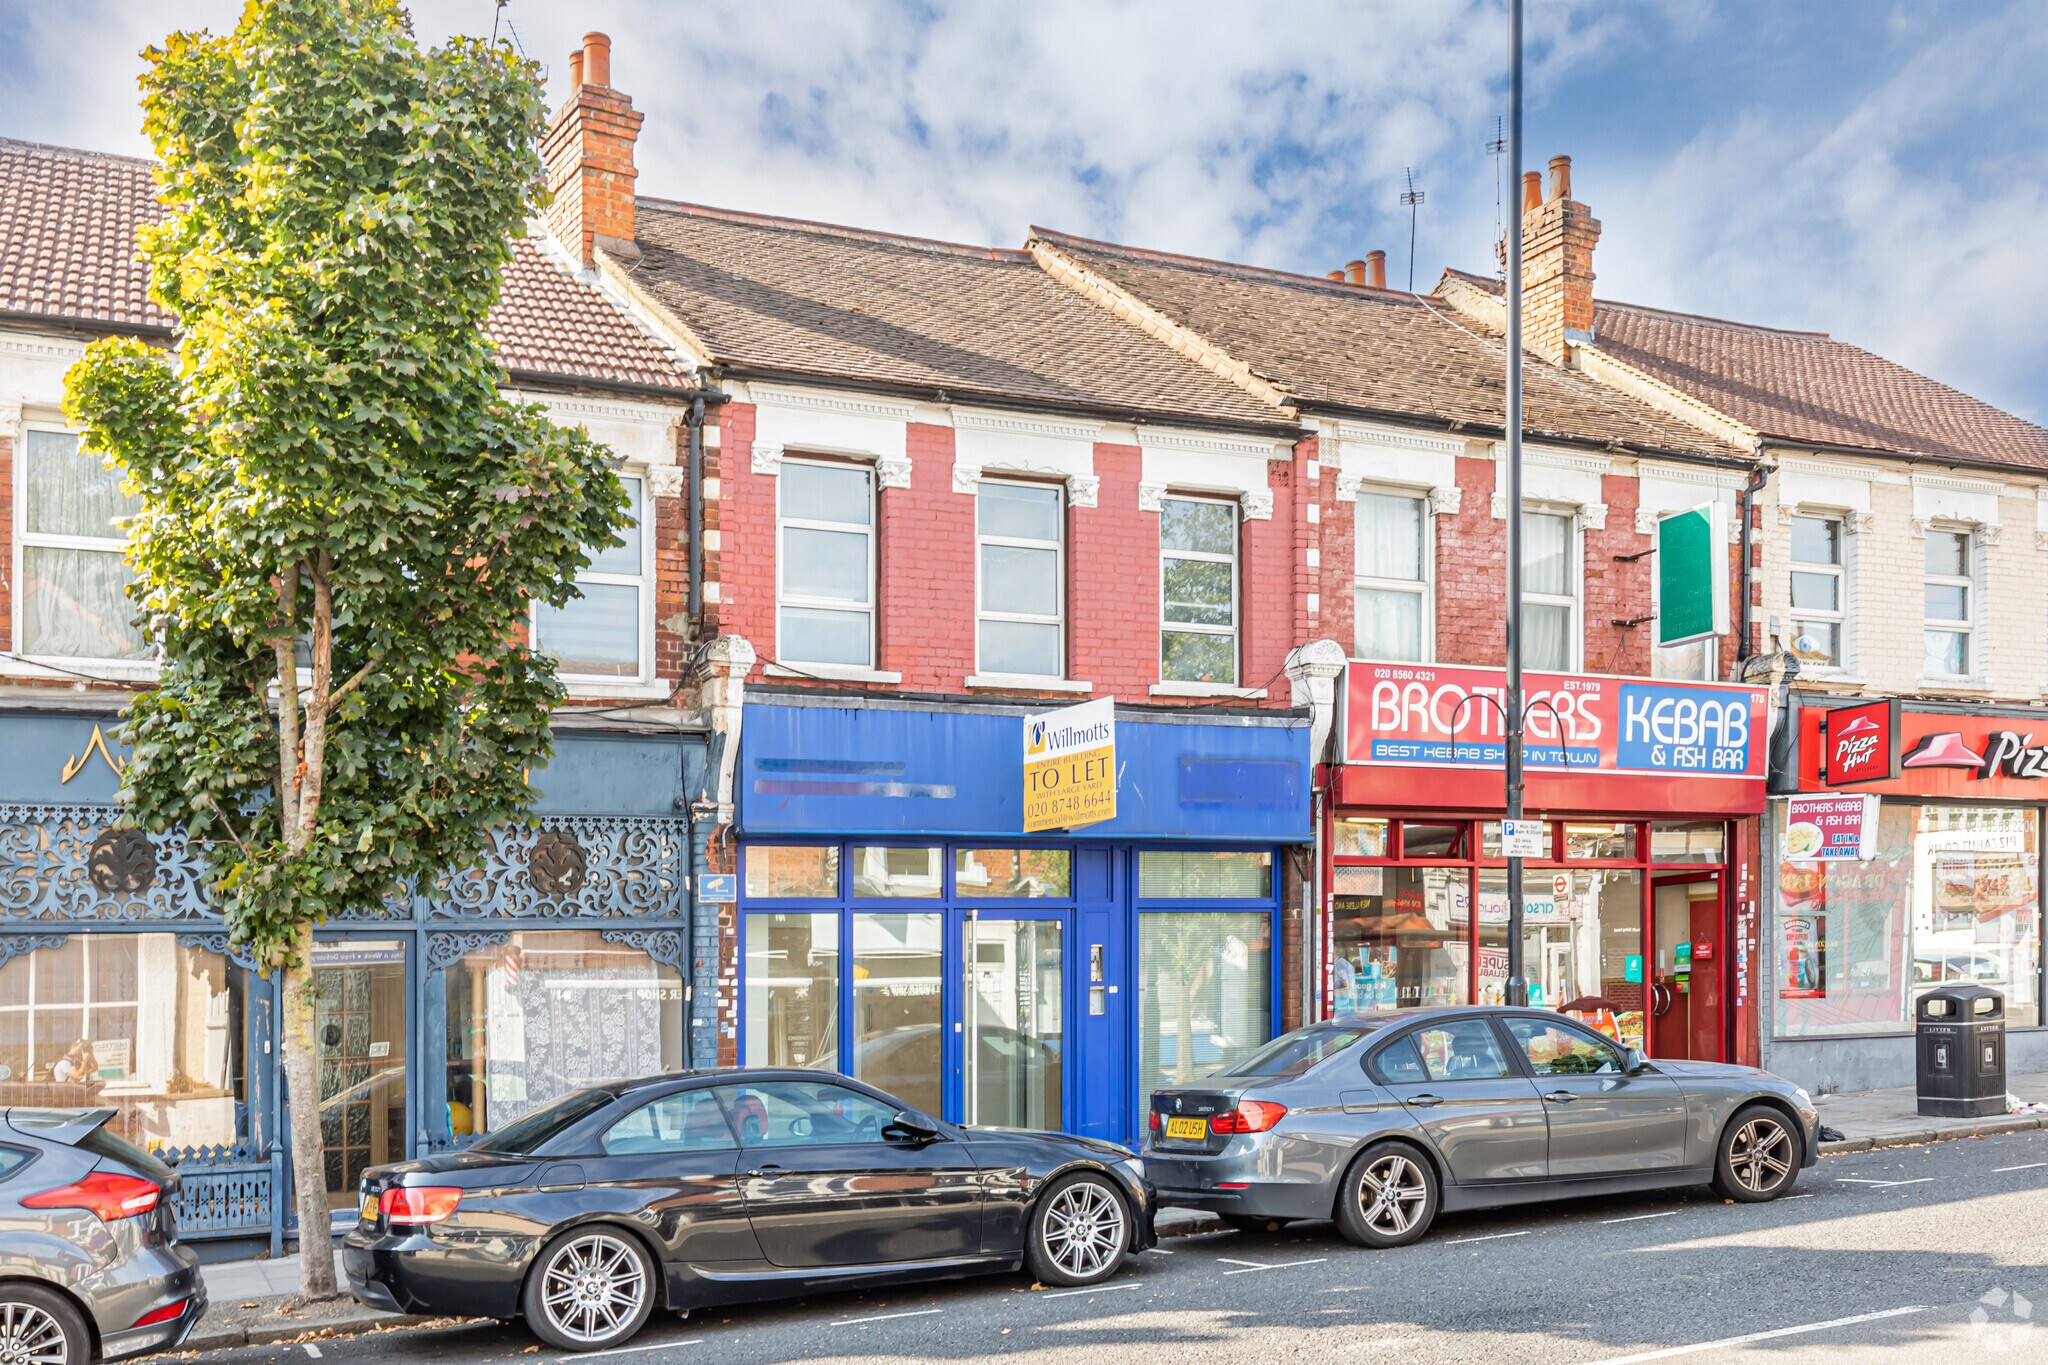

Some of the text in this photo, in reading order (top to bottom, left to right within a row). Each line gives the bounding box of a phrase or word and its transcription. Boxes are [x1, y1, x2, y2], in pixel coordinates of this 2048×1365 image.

[1374, 668, 1435, 681] 020 8560 4321
[1564, 680, 1600, 692] EST.1979
[1750, 694, 1764, 704] 178
[1371, 680, 1601, 741] BROTHERS
[1626, 695, 1748, 748] KEBAB
[1048, 723, 1110, 750] Willmotts
[1376, 744, 1597, 764] BEST KEBAB SHP IN TOWN
[1651, 744, 1744, 770] & FISH BAR
[1836, 734, 1879, 762] Pizza
[1036, 750, 1100, 770] ENTIRE BUILDING
[1842, 747, 1877, 773] Hut
[1029, 756, 1108, 792] TO LET
[1036, 781, 1102, 800] WITH LARGE YARD
[1028, 790, 1111, 818] 020 8748 6644
[1792, 801, 1862, 814] BROTHERS KEBAB
[1027, 807, 1112, 828] commercial@willmotts.com
[1816, 814, 1860, 826] & FISH BAR
[1832, 833, 1860, 844] EAT IN &
[1822, 847, 1859, 857] TAKE AWAY
[1170, 1121, 1188, 1134] AL02
